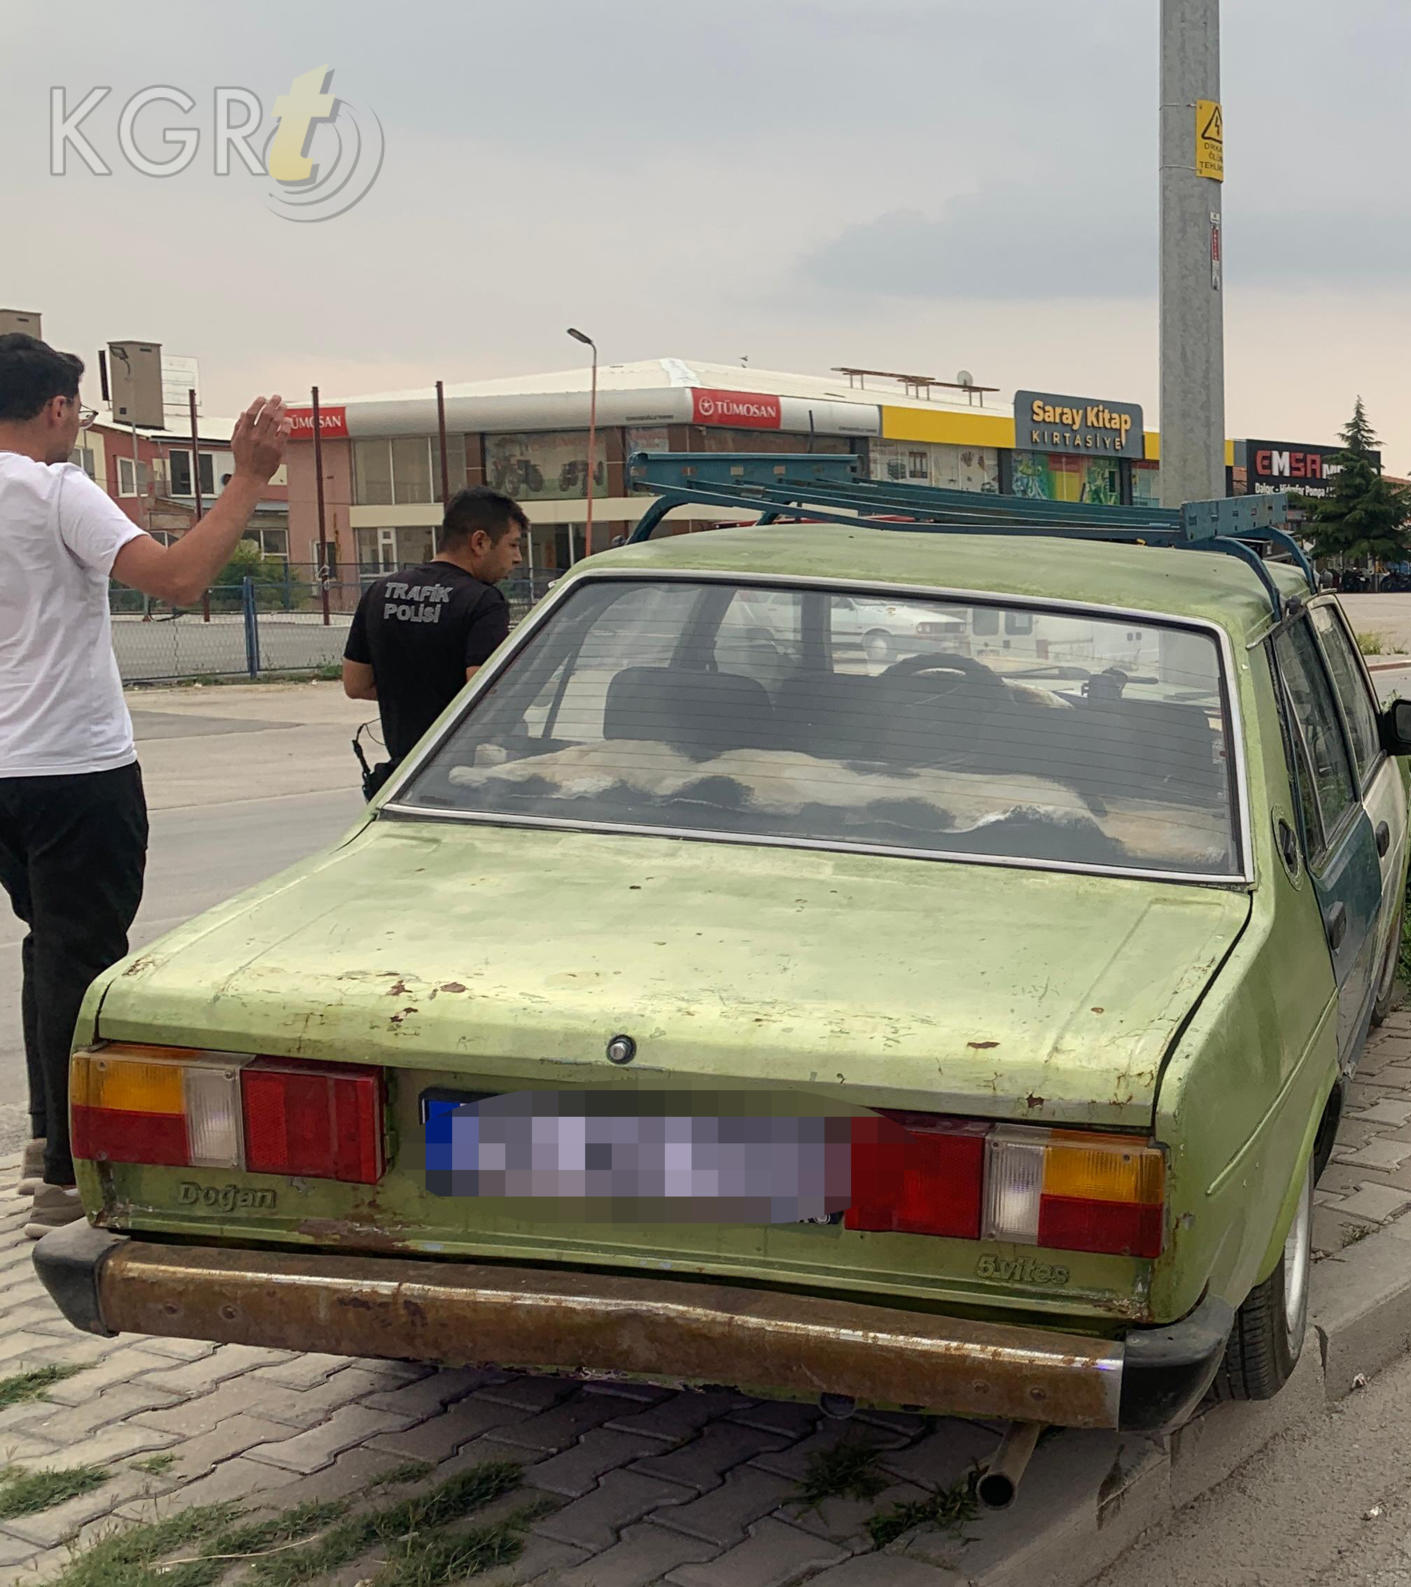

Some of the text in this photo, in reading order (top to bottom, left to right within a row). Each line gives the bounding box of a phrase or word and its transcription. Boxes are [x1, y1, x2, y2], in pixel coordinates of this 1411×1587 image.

[715, 400, 776, 417] TÜMOSAN
[1033, 400, 1131, 447] Saray Kitap
[1032, 430, 1121, 450] KIRTASİYE
[1256, 450, 1322, 478] EMSA
[385, 582, 454, 602] TRAFİK
[384, 603, 441, 623] POLİSİ
[179, 1182, 276, 1212] Doğan
